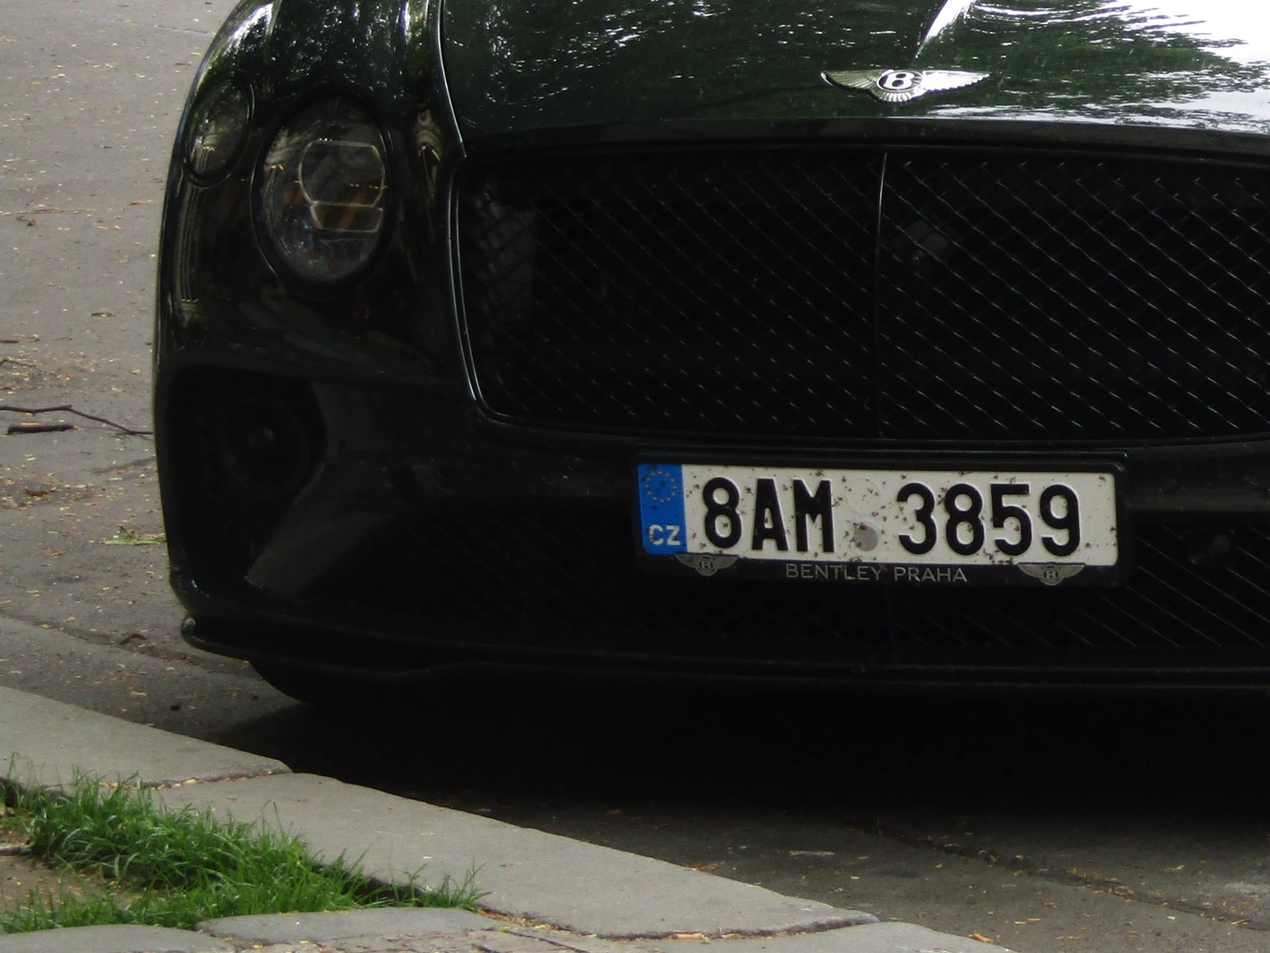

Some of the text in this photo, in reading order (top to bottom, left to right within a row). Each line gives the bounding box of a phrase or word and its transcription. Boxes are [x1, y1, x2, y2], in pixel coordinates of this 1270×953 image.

[702, 477, 1081, 557] 8AM 3859
[648, 524, 681, 546] CZ
[785, 563, 968, 583] BENTLEY PRAHA
